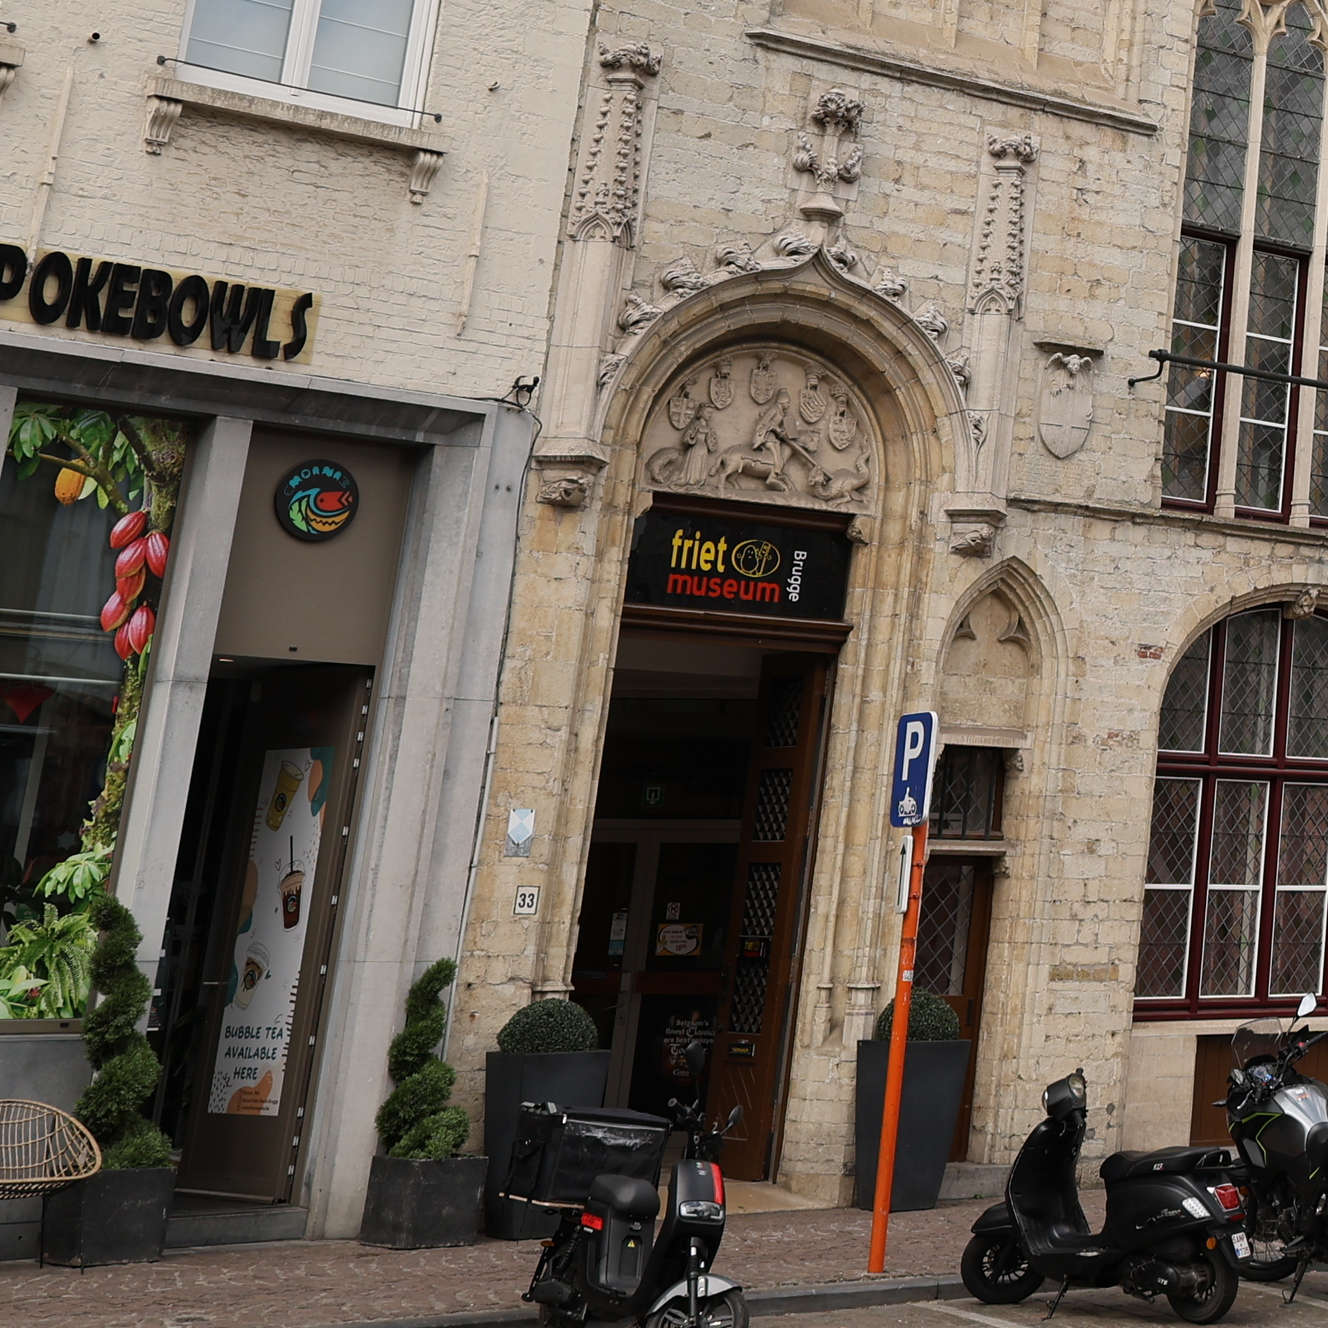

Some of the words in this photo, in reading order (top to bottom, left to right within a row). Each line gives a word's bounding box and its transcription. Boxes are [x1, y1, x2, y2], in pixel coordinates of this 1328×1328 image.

[671, 529, 727, 573] friet
[788, 550, 807, 602] Brugge
[667, 573, 781, 603] museum
[901, 720, 925, 781] P
[517, 892, 535, 909] 33
[224, 1025, 261, 1040] BUBBLE
[264, 1026, 284, 1040] TEA
[224, 1046, 278, 1061] AVAILABLE
[233, 1067, 258, 1081] HERE
